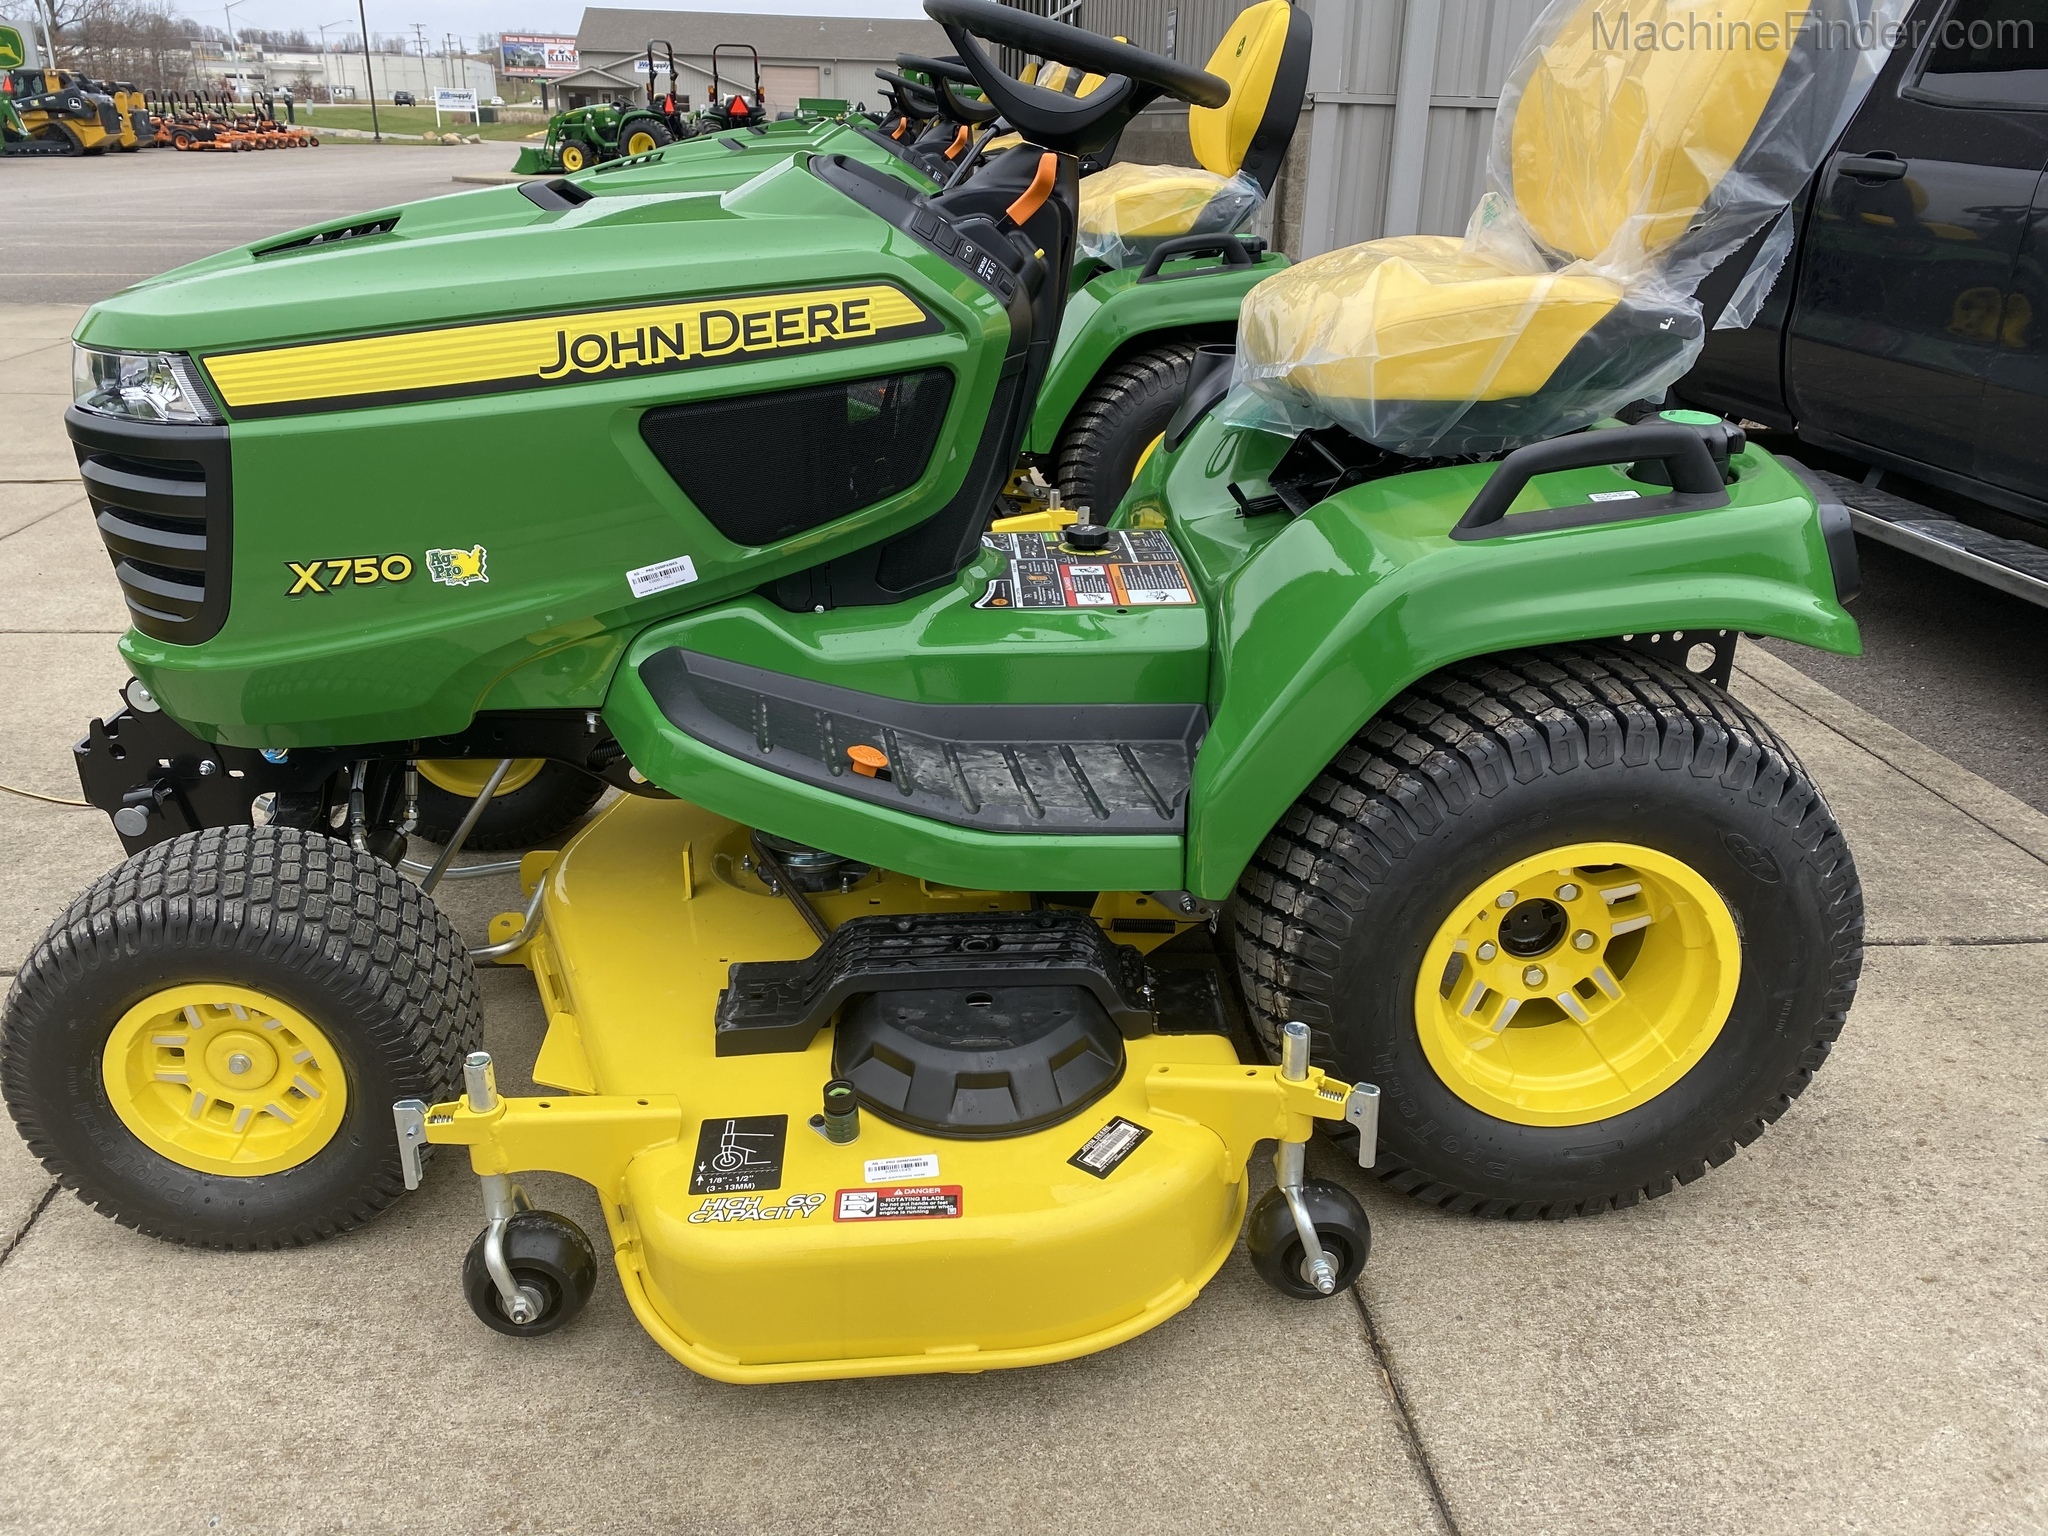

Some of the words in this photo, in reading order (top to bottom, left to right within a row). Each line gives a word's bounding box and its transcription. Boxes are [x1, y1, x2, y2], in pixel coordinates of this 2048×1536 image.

[548, 53, 579, 62] KLINE
[439, 91, 473, 100] Winsupply
[540, 323, 685, 372] JOHN
[699, 298, 878, 358] DEERE
[431, 552, 458, 567] Ag-
[284, 553, 415, 596] X750
[434, 565, 462, 579] Pro
[706, 1185, 716, 1193] (3
[724, 1182, 756, 1191] 13MM)
[904, 1187, 941, 1195] DANGER
[700, 1196, 763, 1212] HIGH
[786, 1193, 826, 1206] 60
[687, 1205, 820, 1223] CAPACITY
